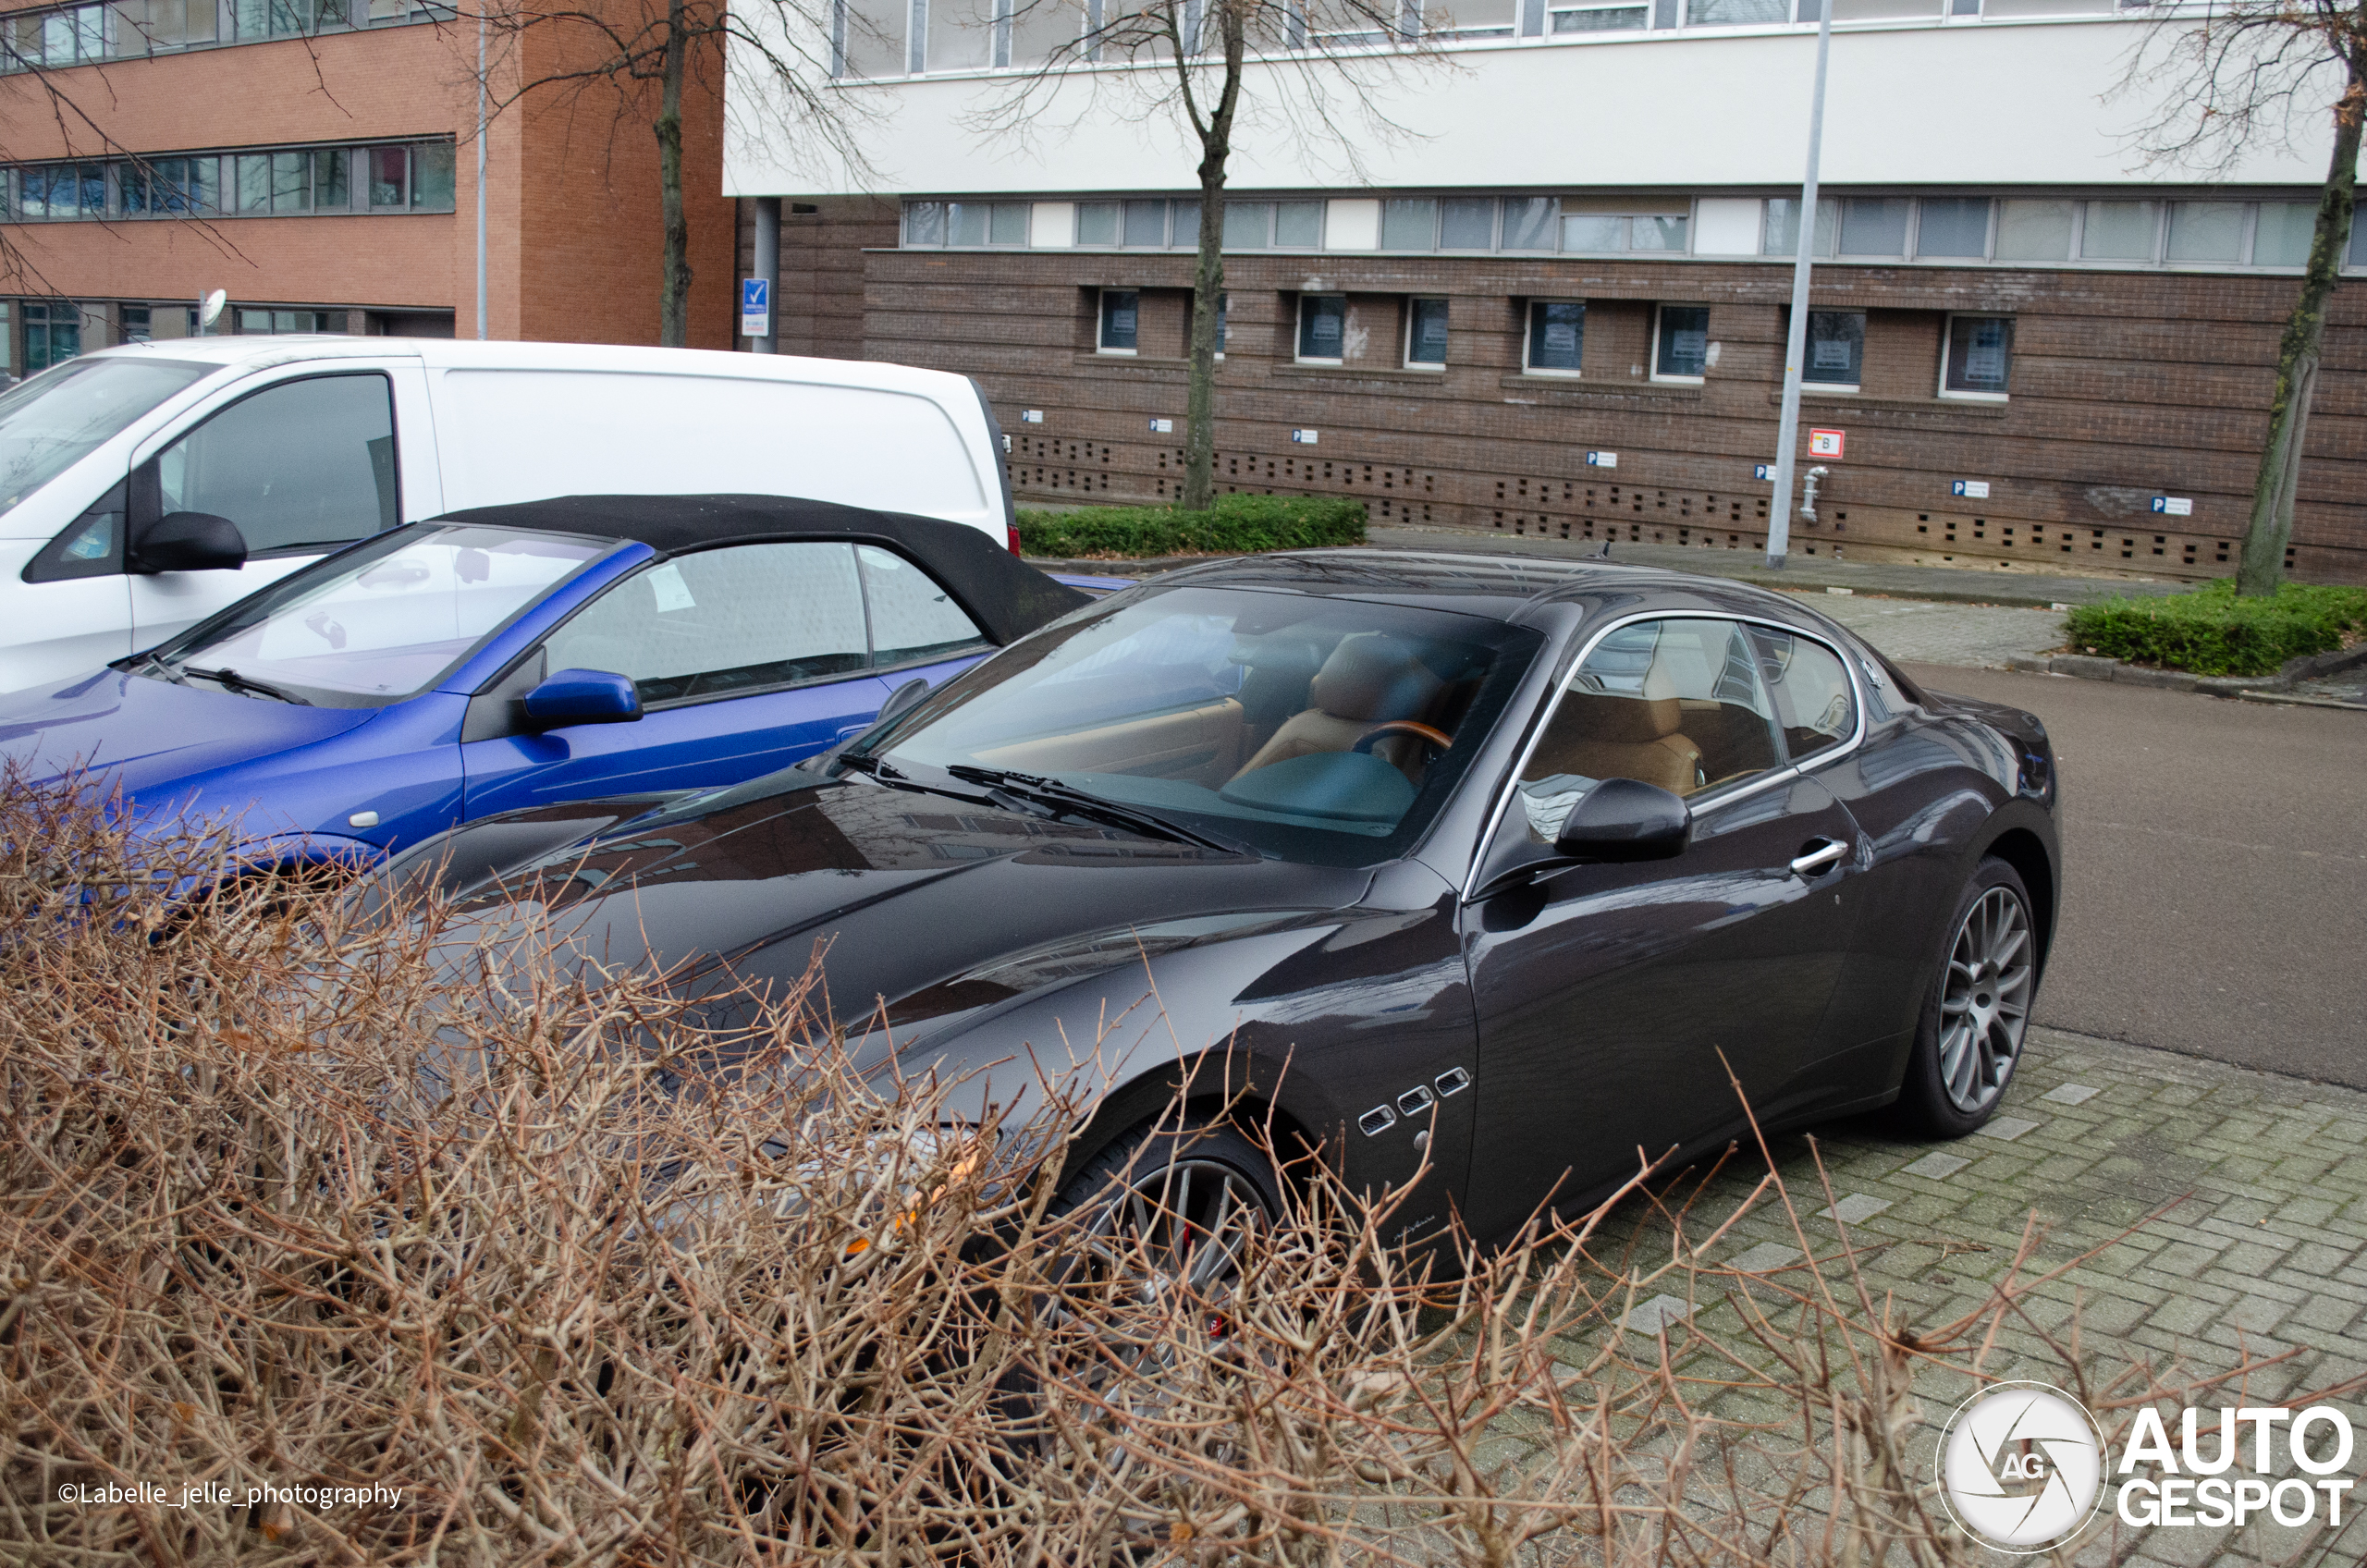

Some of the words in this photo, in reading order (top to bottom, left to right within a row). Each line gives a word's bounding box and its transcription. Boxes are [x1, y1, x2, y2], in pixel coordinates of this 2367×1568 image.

[1150, 420, 1157, 430] P
[1294, 431, 1301, 441] P
[1822, 437, 1830, 449] B
[1588, 453, 1596, 464] P
[1757, 466, 1765, 478] P
[1954, 482, 1964, 495] P
[2153, 498, 2165, 512] P
